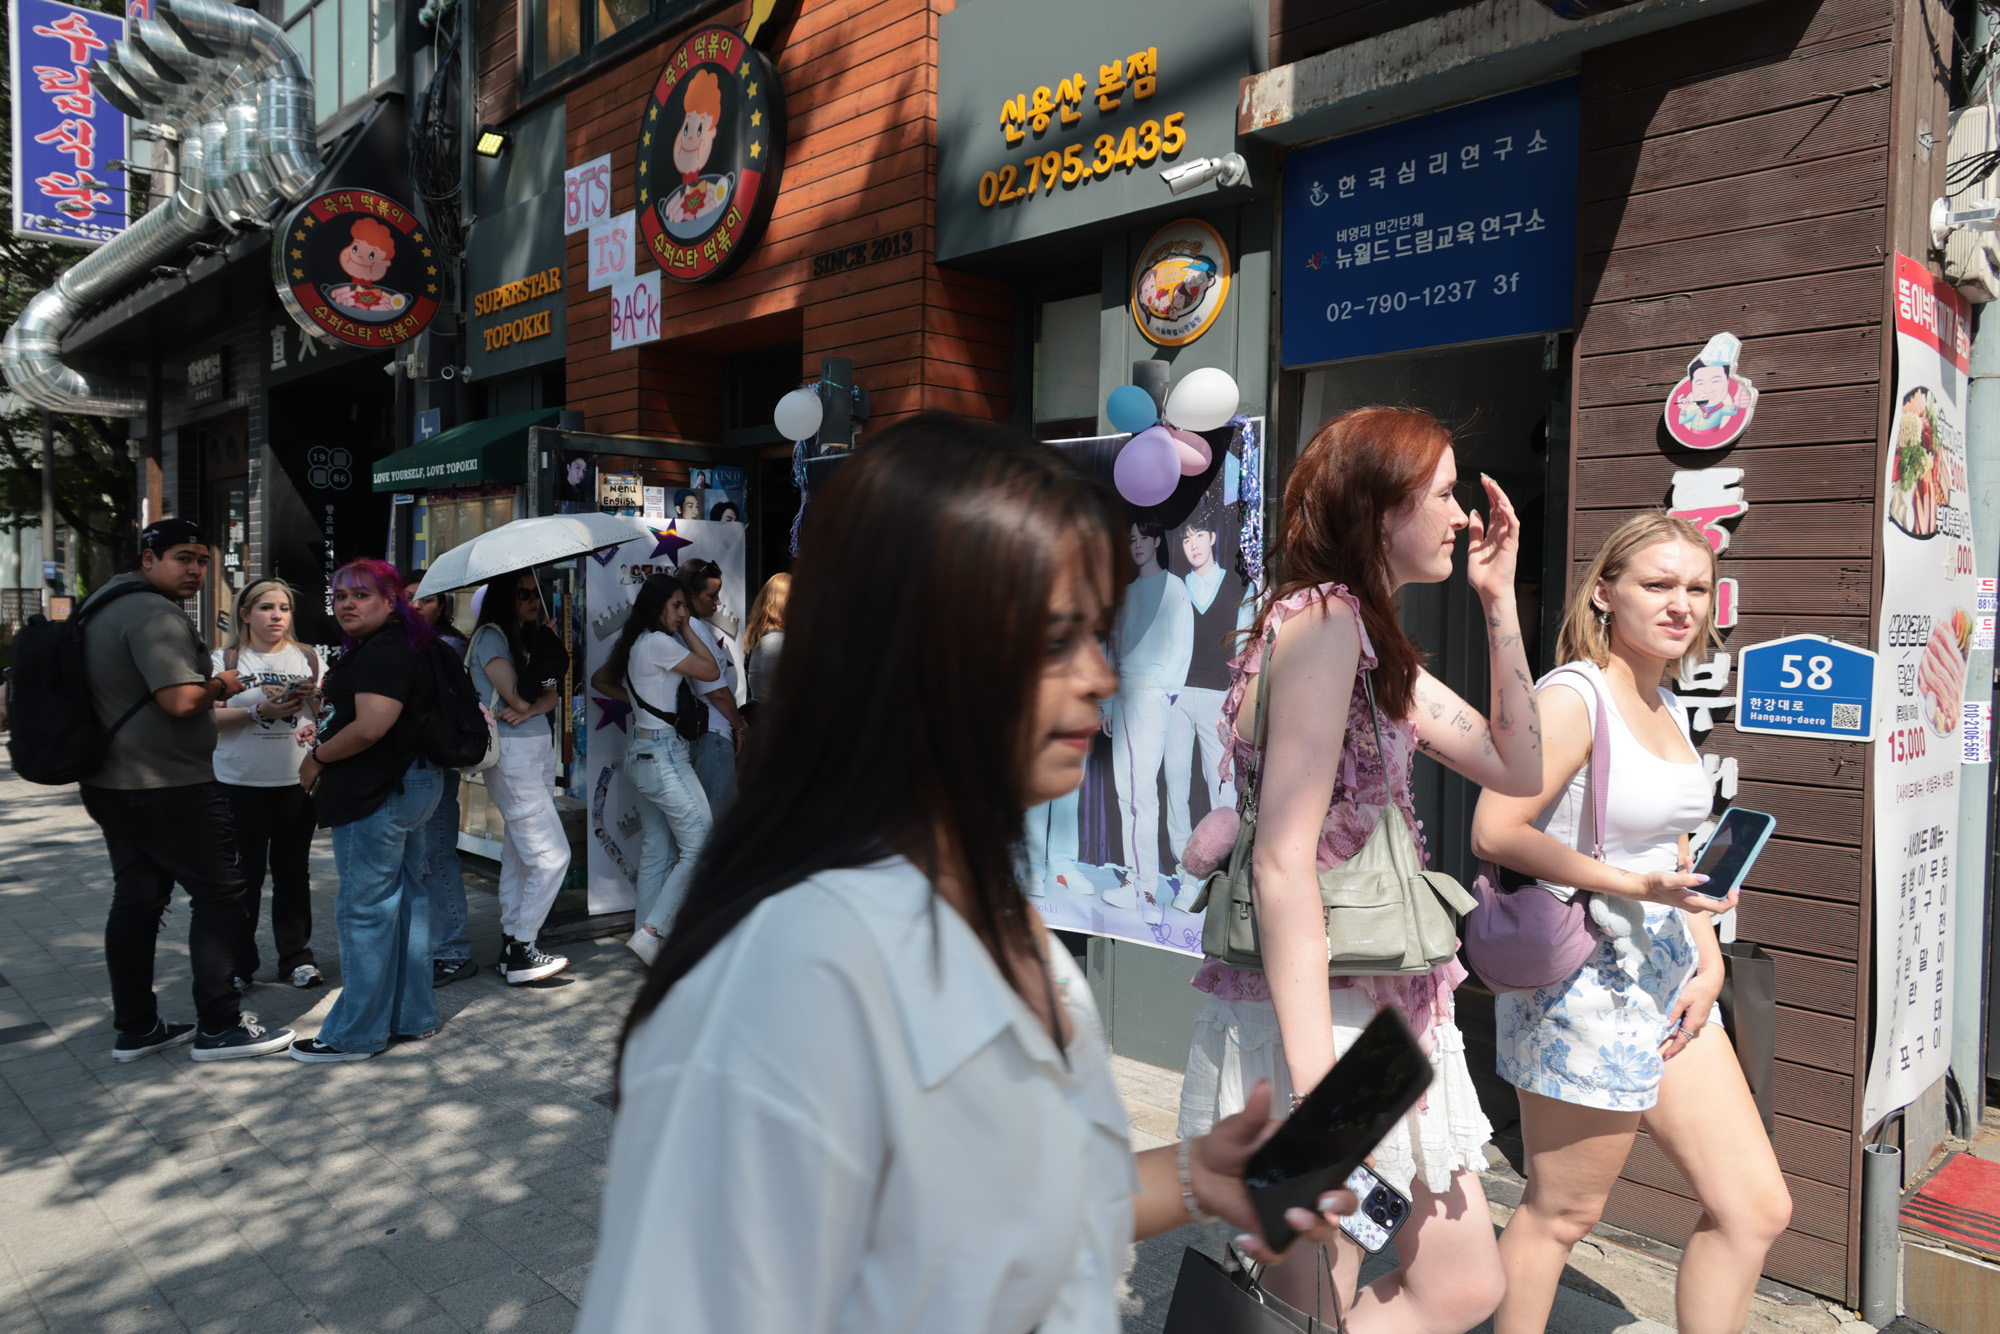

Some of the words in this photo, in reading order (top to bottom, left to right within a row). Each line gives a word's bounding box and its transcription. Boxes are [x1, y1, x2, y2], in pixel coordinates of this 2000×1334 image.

[664, 47, 688, 87] 즉석
[694, 32, 733, 61] 떡볶이
[1000, 73, 1087, 143] 신용산
[1094, 46, 1158, 112] 본점
[33, 12, 111, 219] 수림식당
[978, 111, 1186, 207] 02.795.3435
[322, 193, 353, 214] 즉석
[360, 194, 404, 223] 떡볶이
[566, 164, 609, 226] BTS
[654, 232, 699, 270] 슈퍼스타
[703, 205, 743, 264] 떡볶이
[1336, 224, 1371, 243] 비영리
[1375, 212, 1424, 236] 민간단체
[1336, 239, 1391, 269] 뉴월드
[1481, 208, 1546, 242] 연구소
[594, 228, 627, 275] IS
[813, 242, 867, 276] SINCE
[871, 230, 913, 261] 2013
[475, 267, 562, 317] SUPERSTAR
[612, 282, 660, 340] BACK
[1327, 279, 1477, 322] 02-790-1237
[1493, 272, 1520, 295] 3f
[314, 305, 373, 341] 슈퍼스타
[379, 313, 420, 344] 떡볶이
[484, 310, 551, 351] TOPOKKI
[313, 453, 326, 462] 19
[373, 472, 390, 483] LOVE
[391, 468, 425, 481] YOURSELF,
[426, 465, 445, 476] LOVE
[446, 459, 478, 474] TOPOKKI
[715, 469, 741, 482] CESCO
[333, 473, 347, 483] 86
[609, 485, 637, 494] Menu
[603, 496, 637, 506] English
[1780, 654, 1833, 690] 58
[1750, 697, 1804, 712] 한강대로
[1750, 711, 1826, 726] Hangang-daero
[1888, 726, 1926, 766] 15,000
